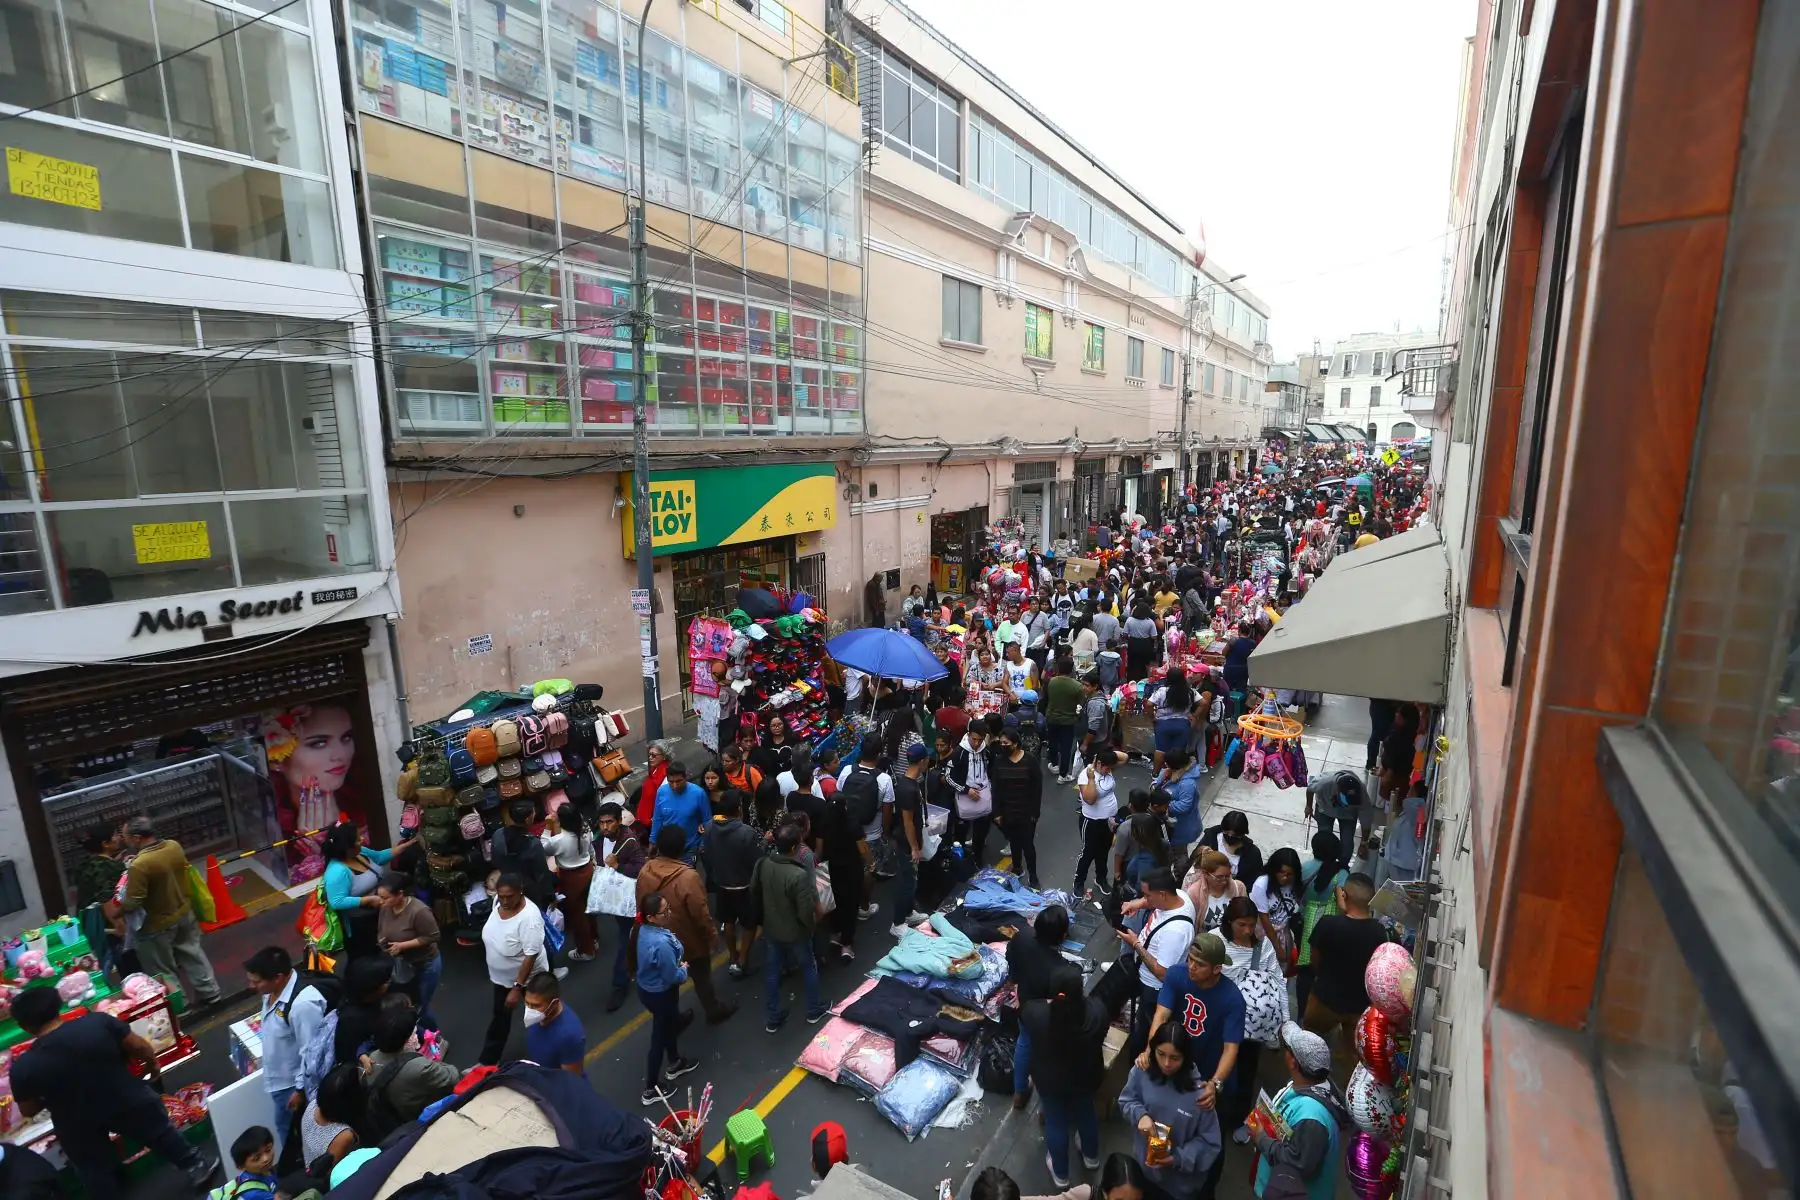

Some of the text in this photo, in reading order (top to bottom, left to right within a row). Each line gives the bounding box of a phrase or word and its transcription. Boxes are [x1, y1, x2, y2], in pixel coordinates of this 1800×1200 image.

[8, 149, 98, 180] SE ALQUILA
[31, 170, 95, 193] TIENDAS
[133, 522, 205, 537] SE ALQUILA
[652, 512, 691, 537] LOY
[130, 590, 304, 638] Mia Secret
[1182, 993, 1208, 1037] B
